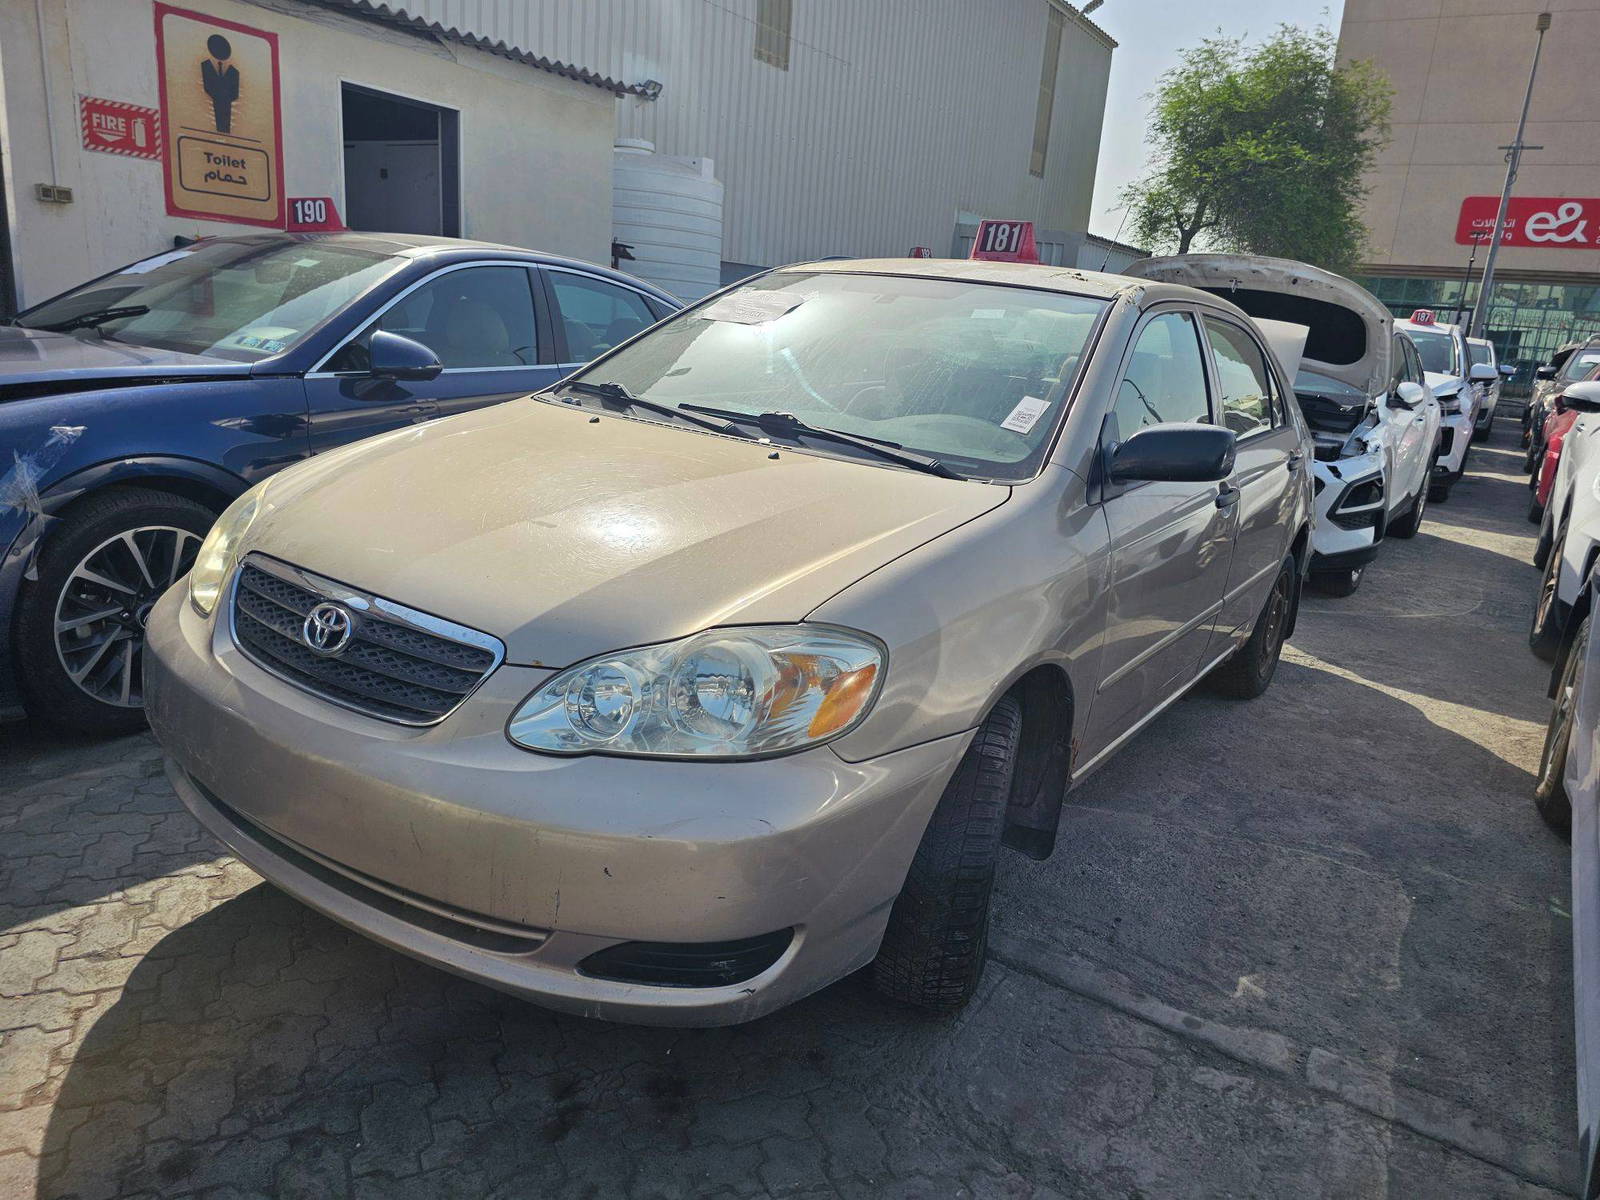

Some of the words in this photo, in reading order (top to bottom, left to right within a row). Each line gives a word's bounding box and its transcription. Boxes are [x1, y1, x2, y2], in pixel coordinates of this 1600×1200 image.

[92, 113, 126, 131] FIRE
[204, 152, 246, 169] Toilet
[204, 170, 248, 185] حمام
[295, 200, 326, 224] 190
[985, 223, 1021, 252] 181
[1417, 312, 1430, 322] 187
